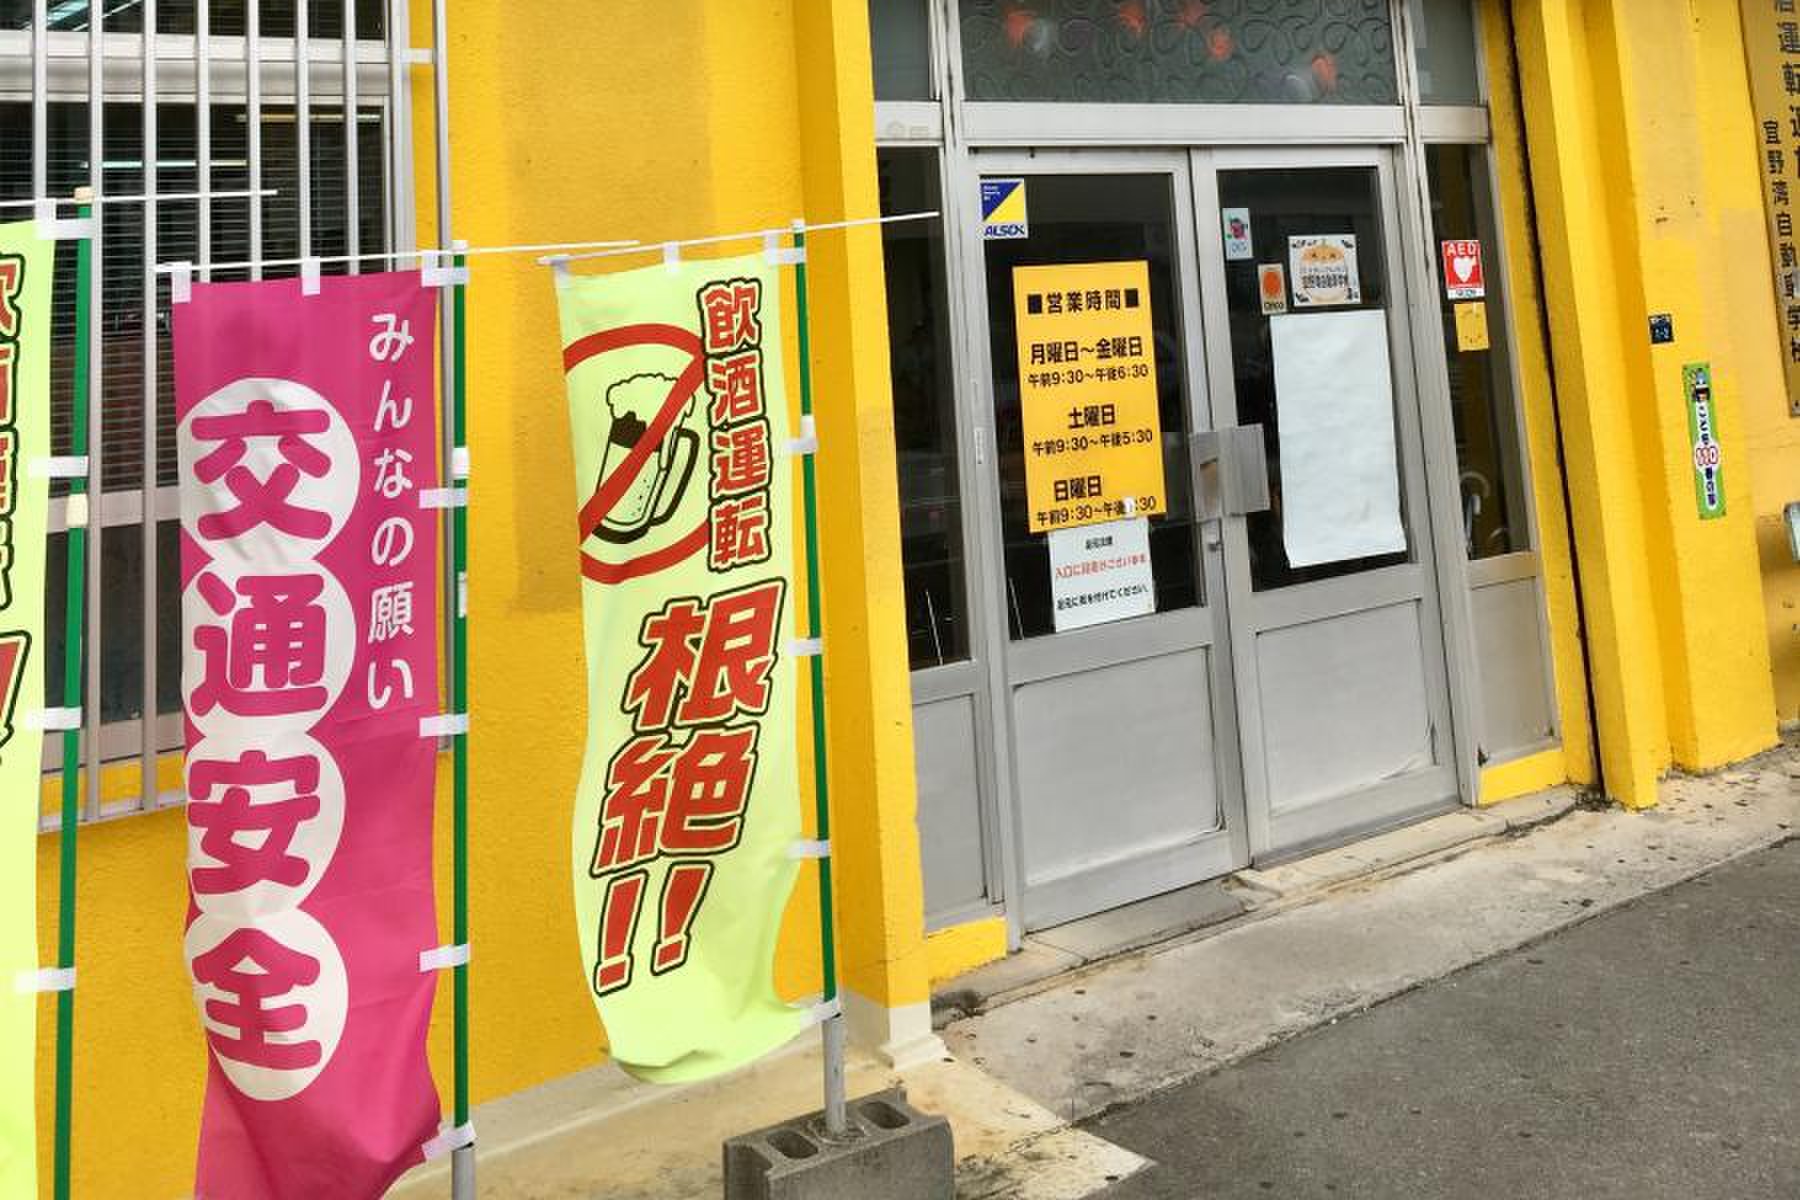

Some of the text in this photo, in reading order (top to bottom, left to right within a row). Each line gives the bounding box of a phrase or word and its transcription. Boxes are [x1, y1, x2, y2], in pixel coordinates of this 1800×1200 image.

[1446, 242, 1478, 256] AED
[1046, 289, 1121, 314] 営業時間
[698, 279, 771, 571] 飲酒運転
[1067, 403, 1116, 429] 土曜日
[1053, 474, 1103, 502] 日曜日
[367, 312, 415, 711] みんなの願い
[1036, 495, 1157, 527] 午前9:30～午後:30
[187, 399, 331, 1071] 交通安全
